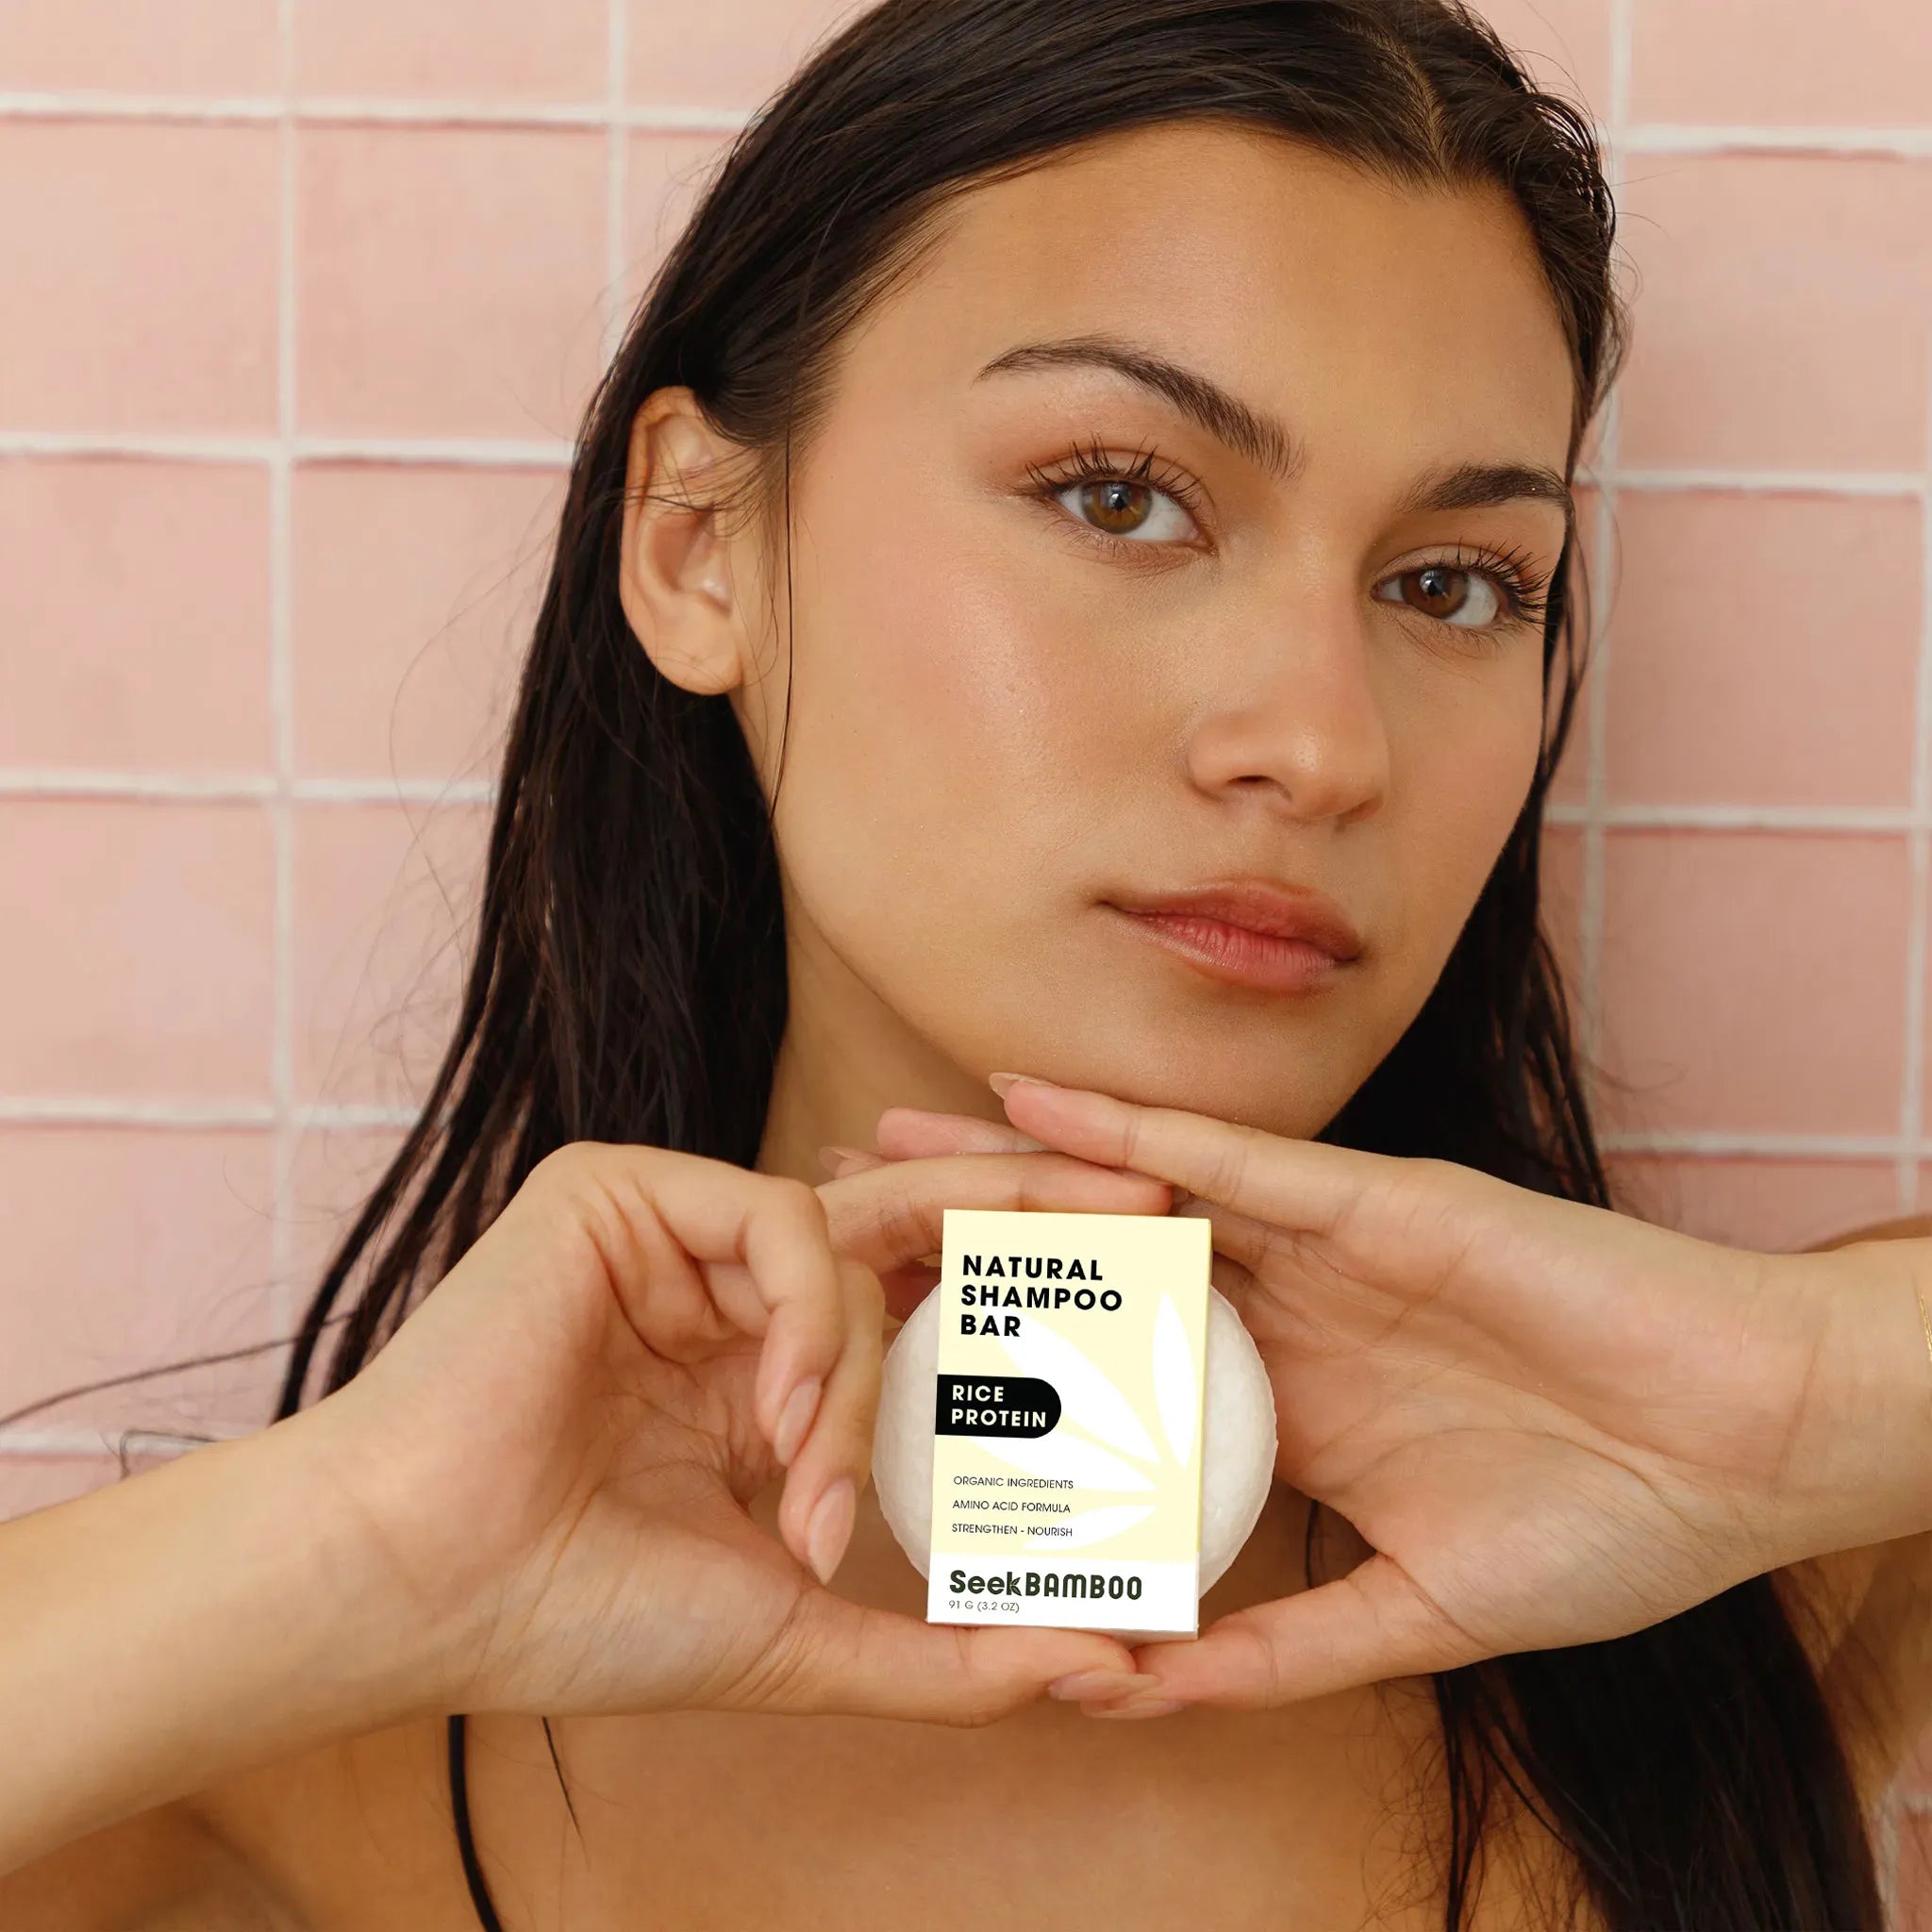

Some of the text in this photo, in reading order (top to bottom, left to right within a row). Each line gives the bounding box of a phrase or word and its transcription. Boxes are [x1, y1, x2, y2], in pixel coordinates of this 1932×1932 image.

[962, 1255, 1103, 1280] NATURAL
[961, 1285, 1122, 1311] SHAMPOO
[960, 1314, 1021, 1337] BAR
[953, 1385, 1004, 1402] RICE
[952, 1408, 1045, 1427] PROTEIN
[953, 1475, 1074, 1490] ORGANIC INGREDIENTS
[952, 1499, 1071, 1513] AMINO ACID FORMULA
[951, 1523, 1018, 1535] STRENGTHEN
[1026, 1525, 1073, 1537] NOURISH
[948, 1600, 1020, 1614] 91 G (3.2 OZ)
